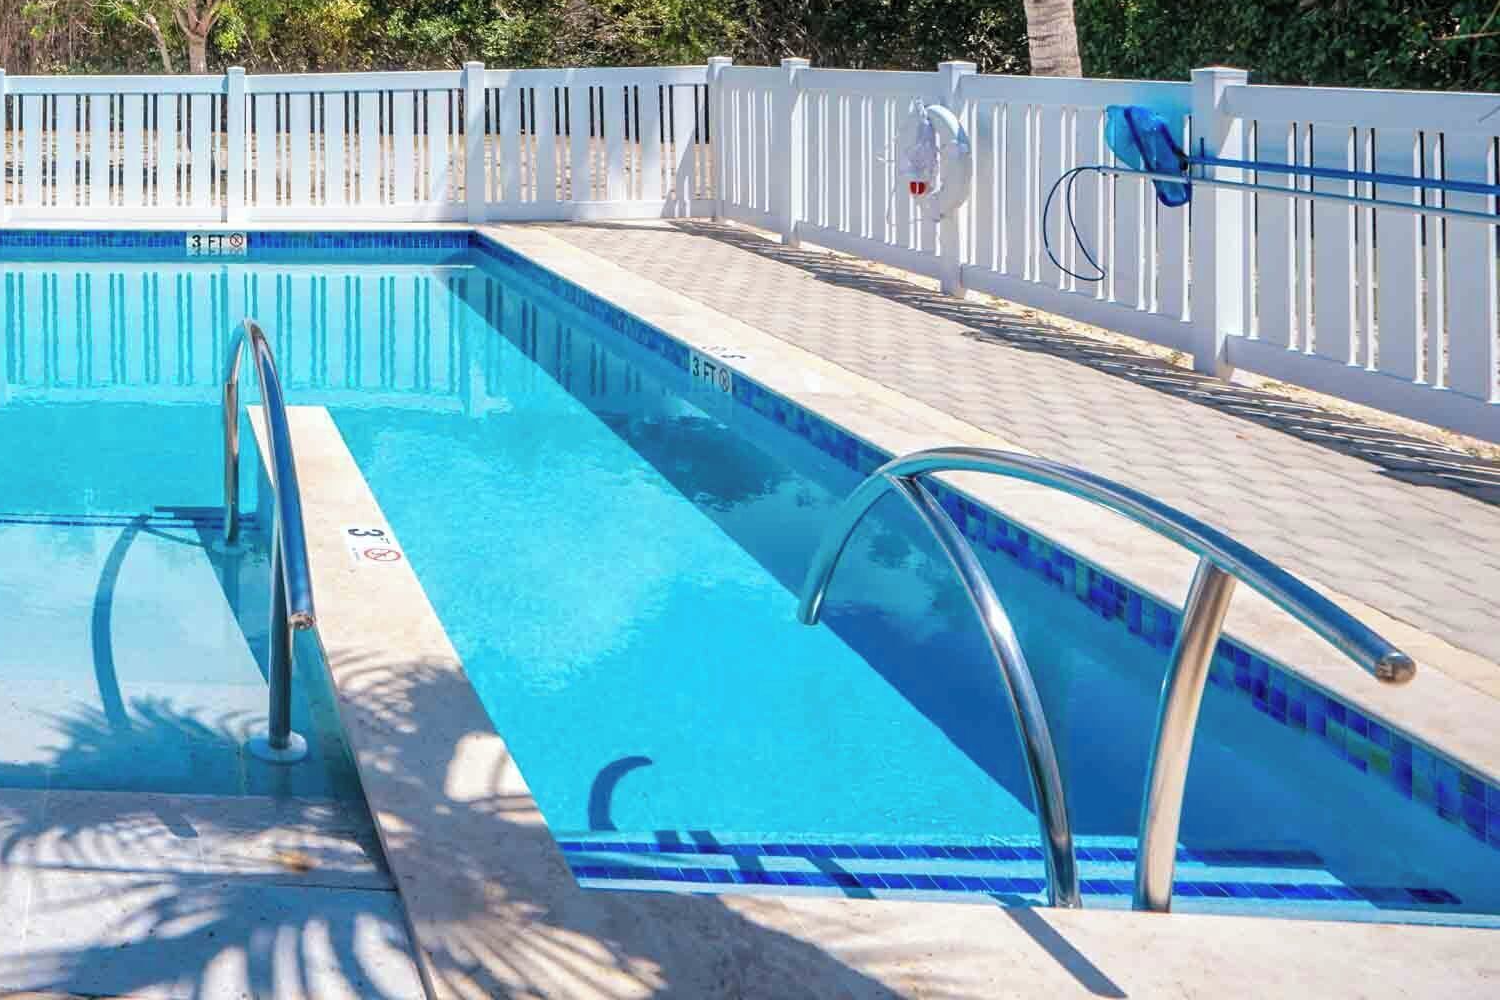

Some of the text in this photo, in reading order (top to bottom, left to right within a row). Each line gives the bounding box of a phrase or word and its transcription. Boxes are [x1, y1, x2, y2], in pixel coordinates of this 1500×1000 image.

[192, 234, 225, 249] 3 FT
[692, 356, 717, 385] 3 FT
[347, 527, 385, 537] 3
